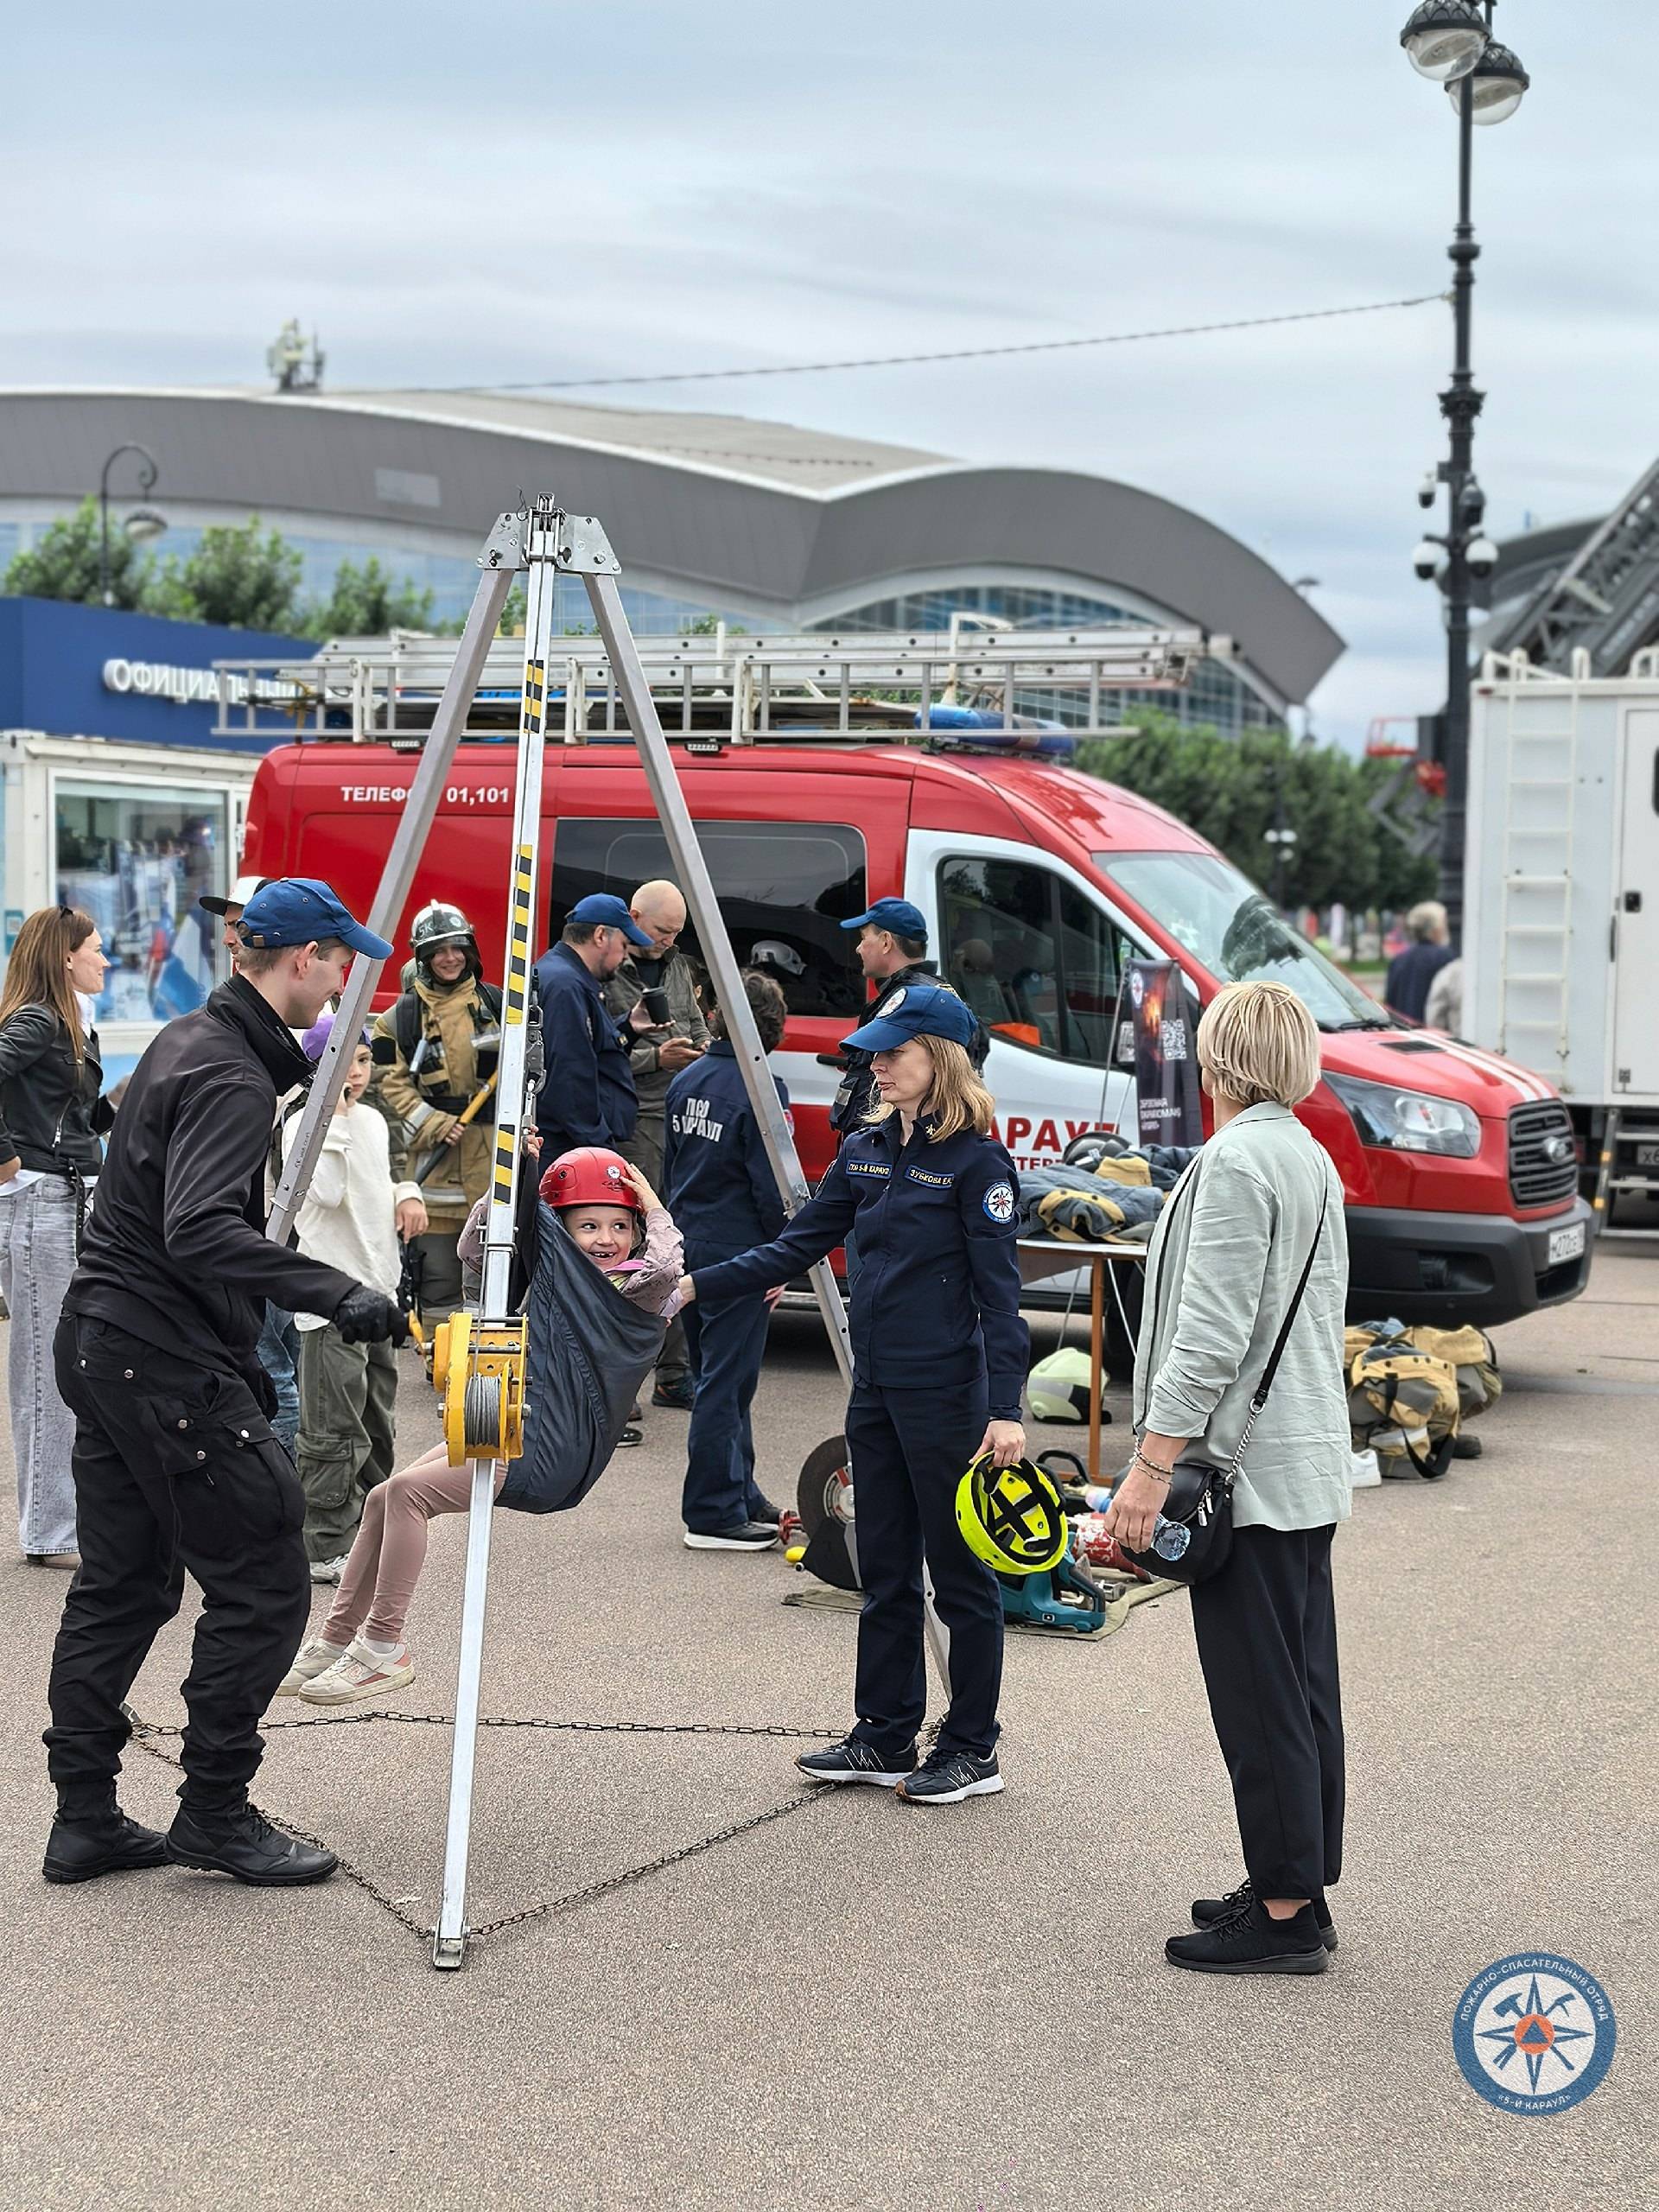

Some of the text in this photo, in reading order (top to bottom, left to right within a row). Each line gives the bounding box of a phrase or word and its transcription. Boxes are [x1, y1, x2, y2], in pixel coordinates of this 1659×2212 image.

[340, 786, 509, 805] ТЕЛЕФ 01,101
[672, 1115, 680, 1133] 5
[910, 1169, 942, 1184] ЗУБКОВА
